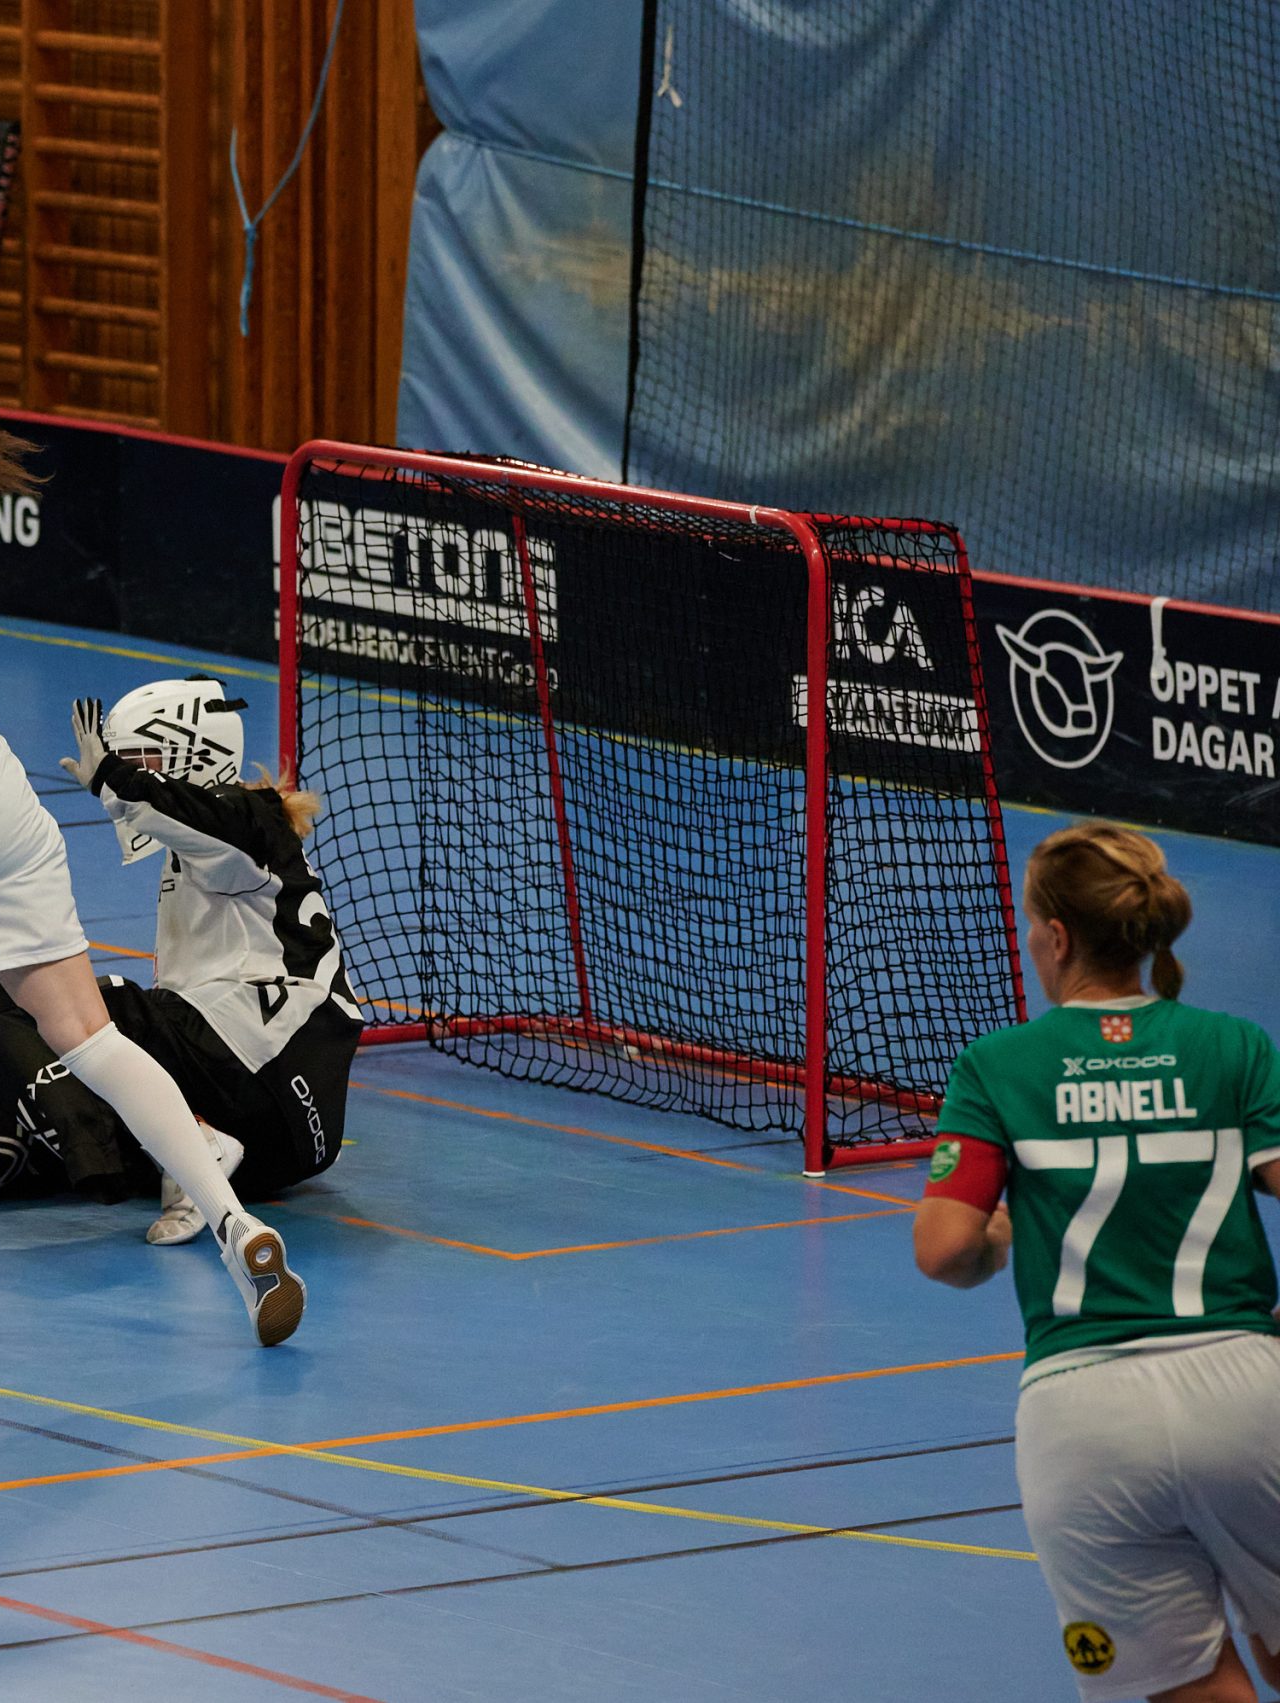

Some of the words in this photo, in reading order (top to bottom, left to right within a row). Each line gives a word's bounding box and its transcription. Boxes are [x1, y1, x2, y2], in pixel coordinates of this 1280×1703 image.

[832, 691, 966, 742] VANTUM
[1152, 715, 1276, 779] DAGAR
[1086, 1053, 1177, 1071] OXDOG
[291, 1074, 327, 1166] OXDOG
[1055, 1077, 1198, 1125] ABNELL
[1013, 1127, 1244, 1318] 77
